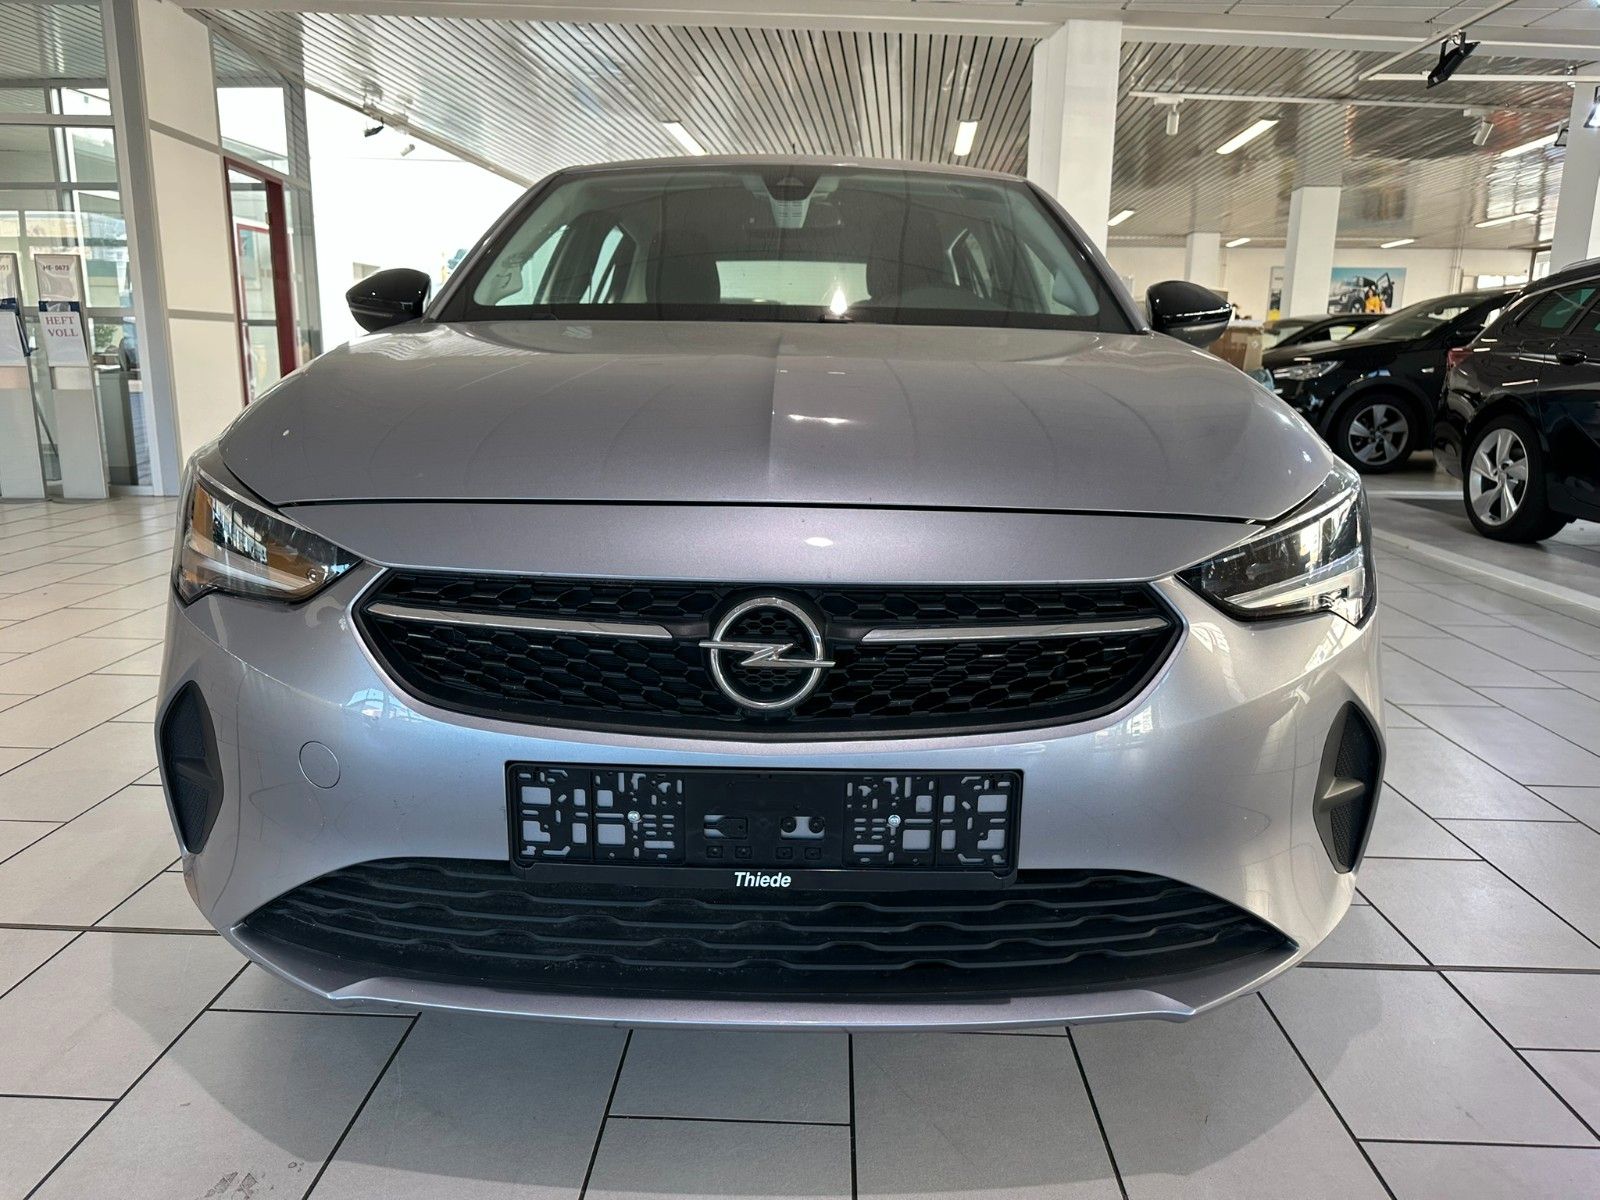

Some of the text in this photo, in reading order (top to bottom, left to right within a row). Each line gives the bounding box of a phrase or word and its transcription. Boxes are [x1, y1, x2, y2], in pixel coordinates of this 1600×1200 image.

[45, 315, 74, 325] HEFT
[47, 328, 78, 338] VOLL
[734, 871, 792, 888] Thiede
